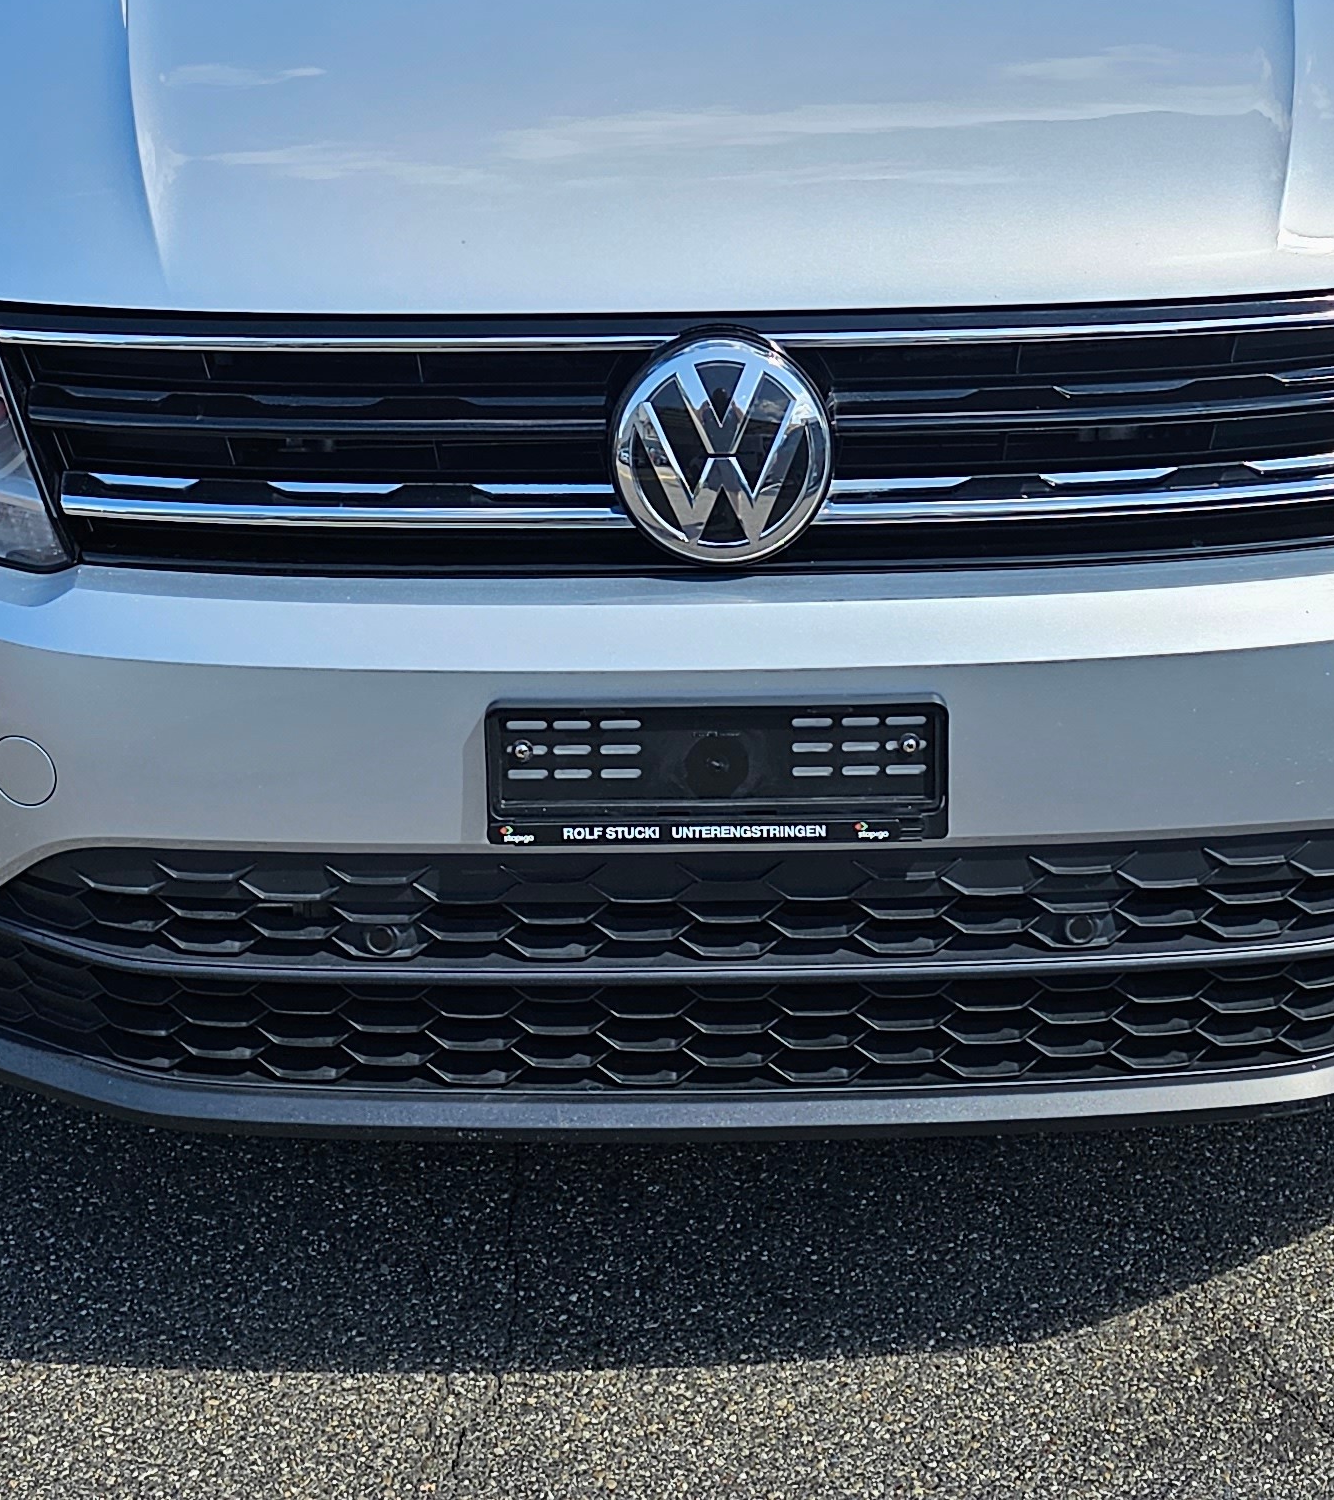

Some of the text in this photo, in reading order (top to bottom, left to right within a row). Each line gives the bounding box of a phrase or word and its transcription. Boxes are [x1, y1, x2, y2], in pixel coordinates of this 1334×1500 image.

[617, 345, 827, 555] VW
[563, 825, 826, 840] ROLF STUCKI UNTERENGSTRINGEN
